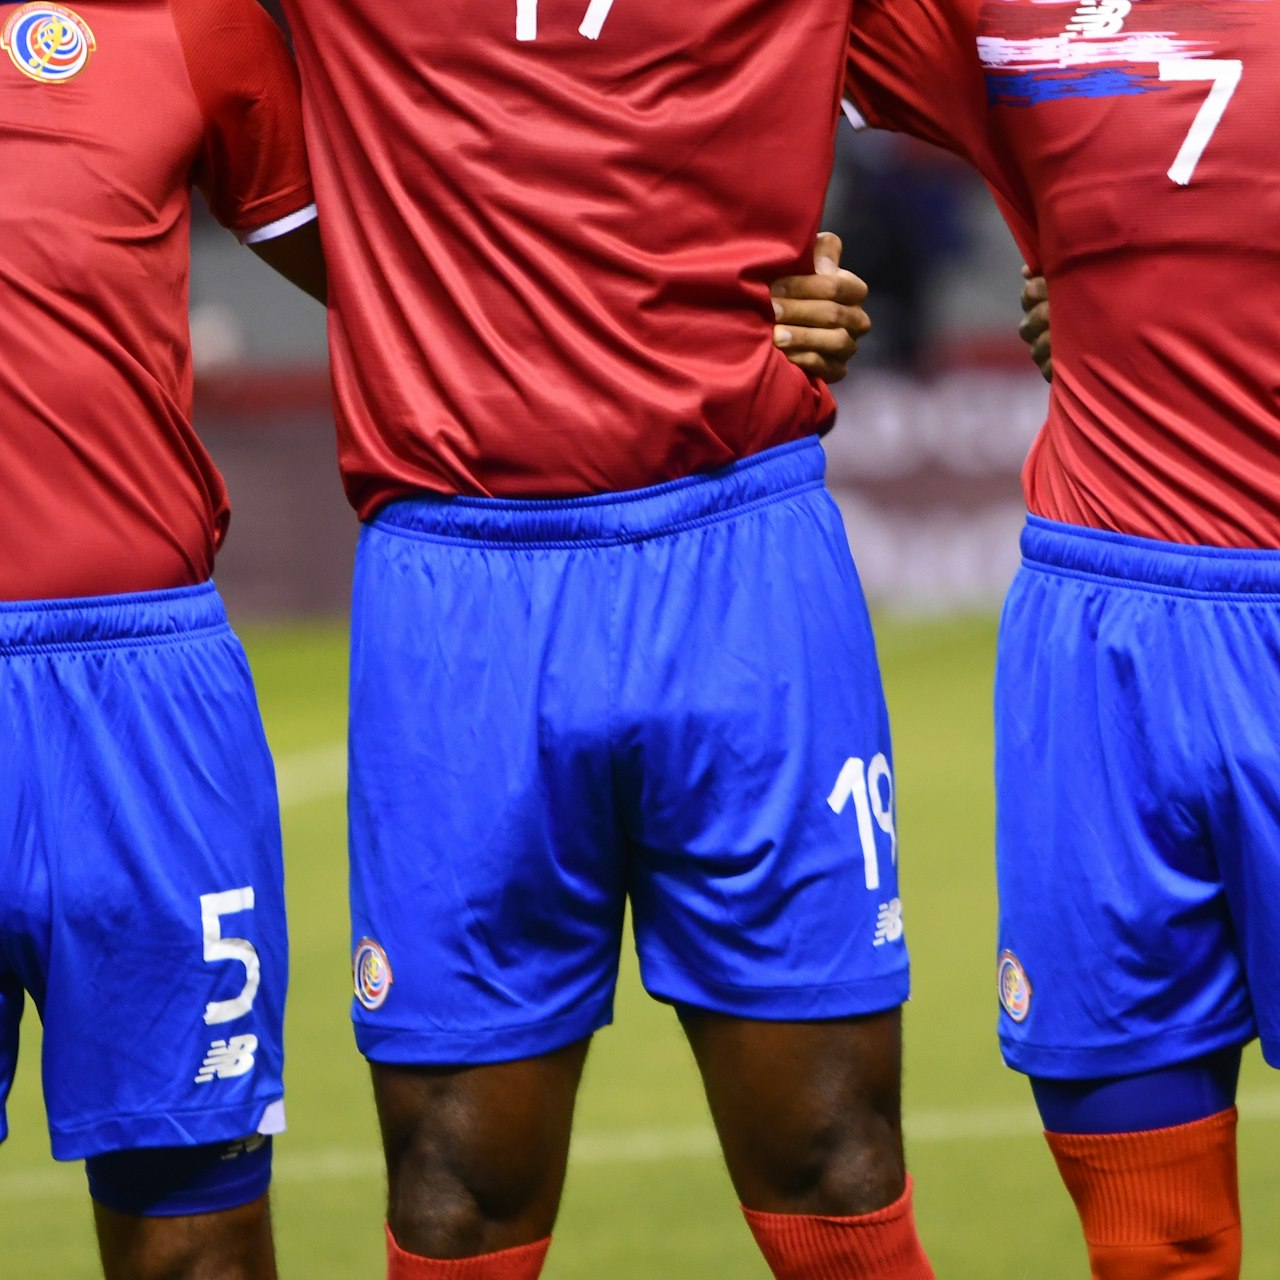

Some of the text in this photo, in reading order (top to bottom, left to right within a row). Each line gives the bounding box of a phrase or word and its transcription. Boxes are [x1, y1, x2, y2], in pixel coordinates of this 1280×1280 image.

[1158, 59, 1243, 185] 7
[826, 751, 897, 890] 19
[200, 885, 260, 1025] 5
